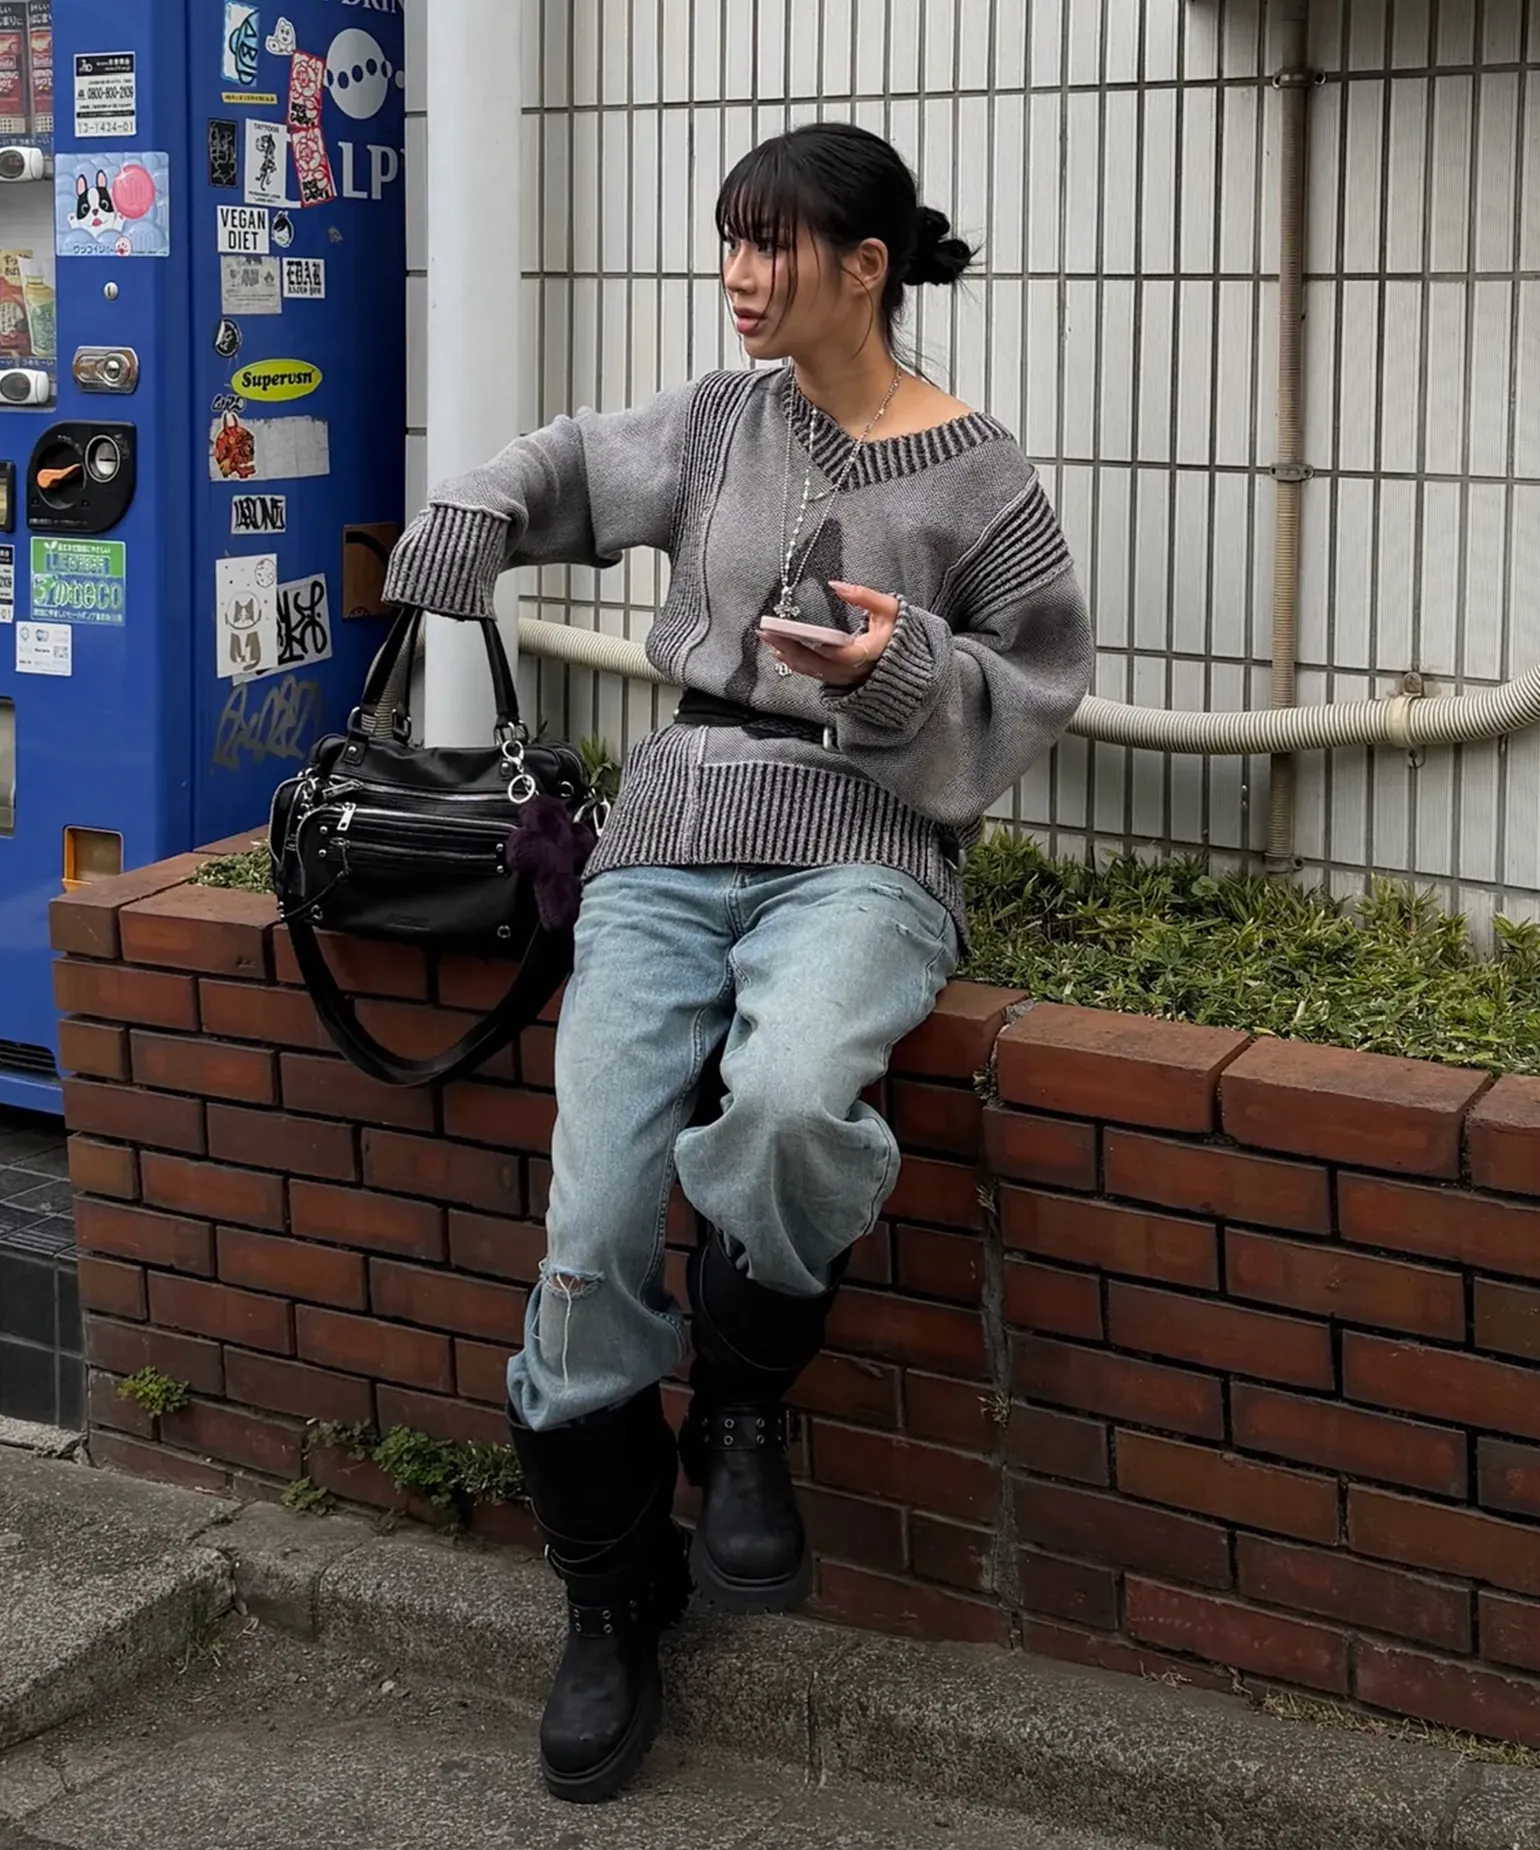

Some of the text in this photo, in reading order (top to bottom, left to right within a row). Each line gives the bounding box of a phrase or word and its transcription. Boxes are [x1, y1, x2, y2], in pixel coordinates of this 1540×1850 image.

[338, 141, 405, 200] LP
[220, 208, 266, 230] VEGAN
[228, 230, 259, 251] DIET
[241, 370, 314, 392] Supervsn
